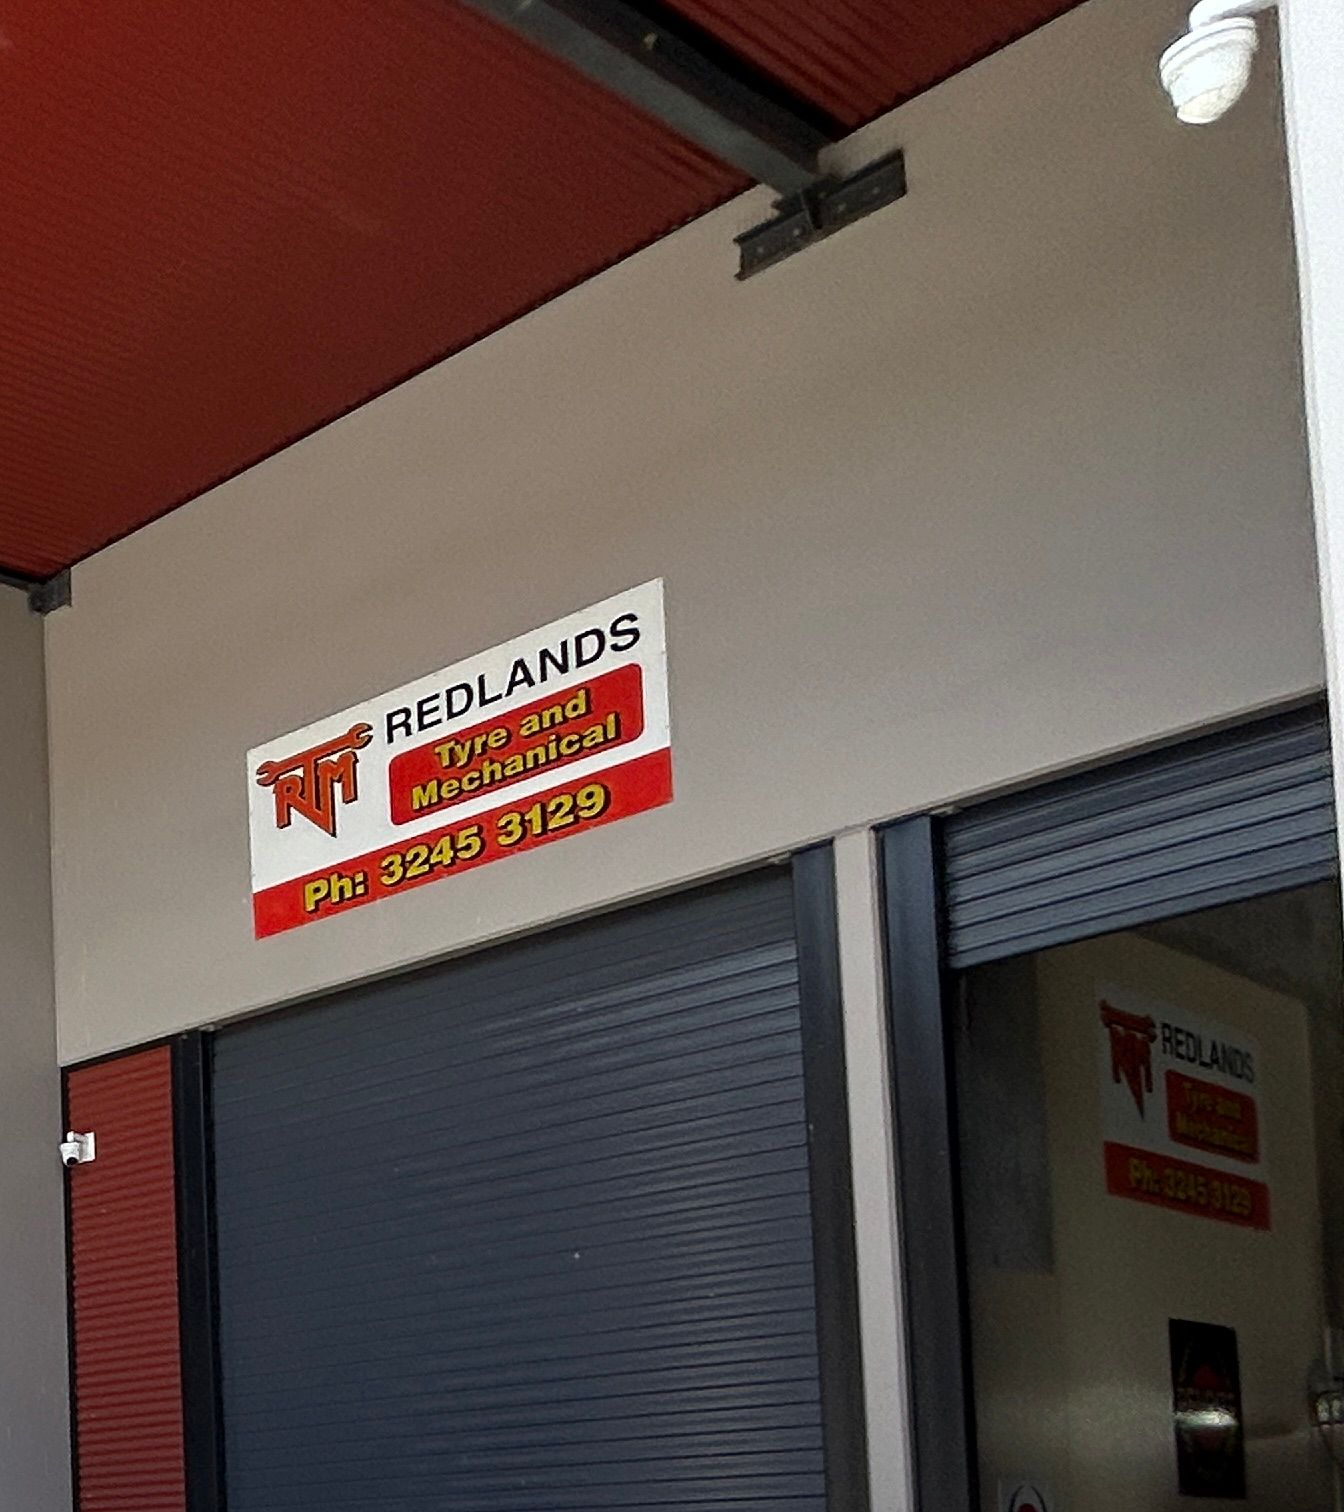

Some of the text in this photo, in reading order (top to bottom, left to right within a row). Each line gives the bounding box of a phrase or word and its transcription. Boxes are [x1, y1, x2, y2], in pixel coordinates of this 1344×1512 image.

[386, 612, 642, 744] REDLANDS
[410, 713, 620, 811] Mechanical
[434, 688, 591, 770] Tyre and
[303, 784, 611, 913] Ph: 3245 3129
[1160, 1022, 1254, 1084] REDLANDS
